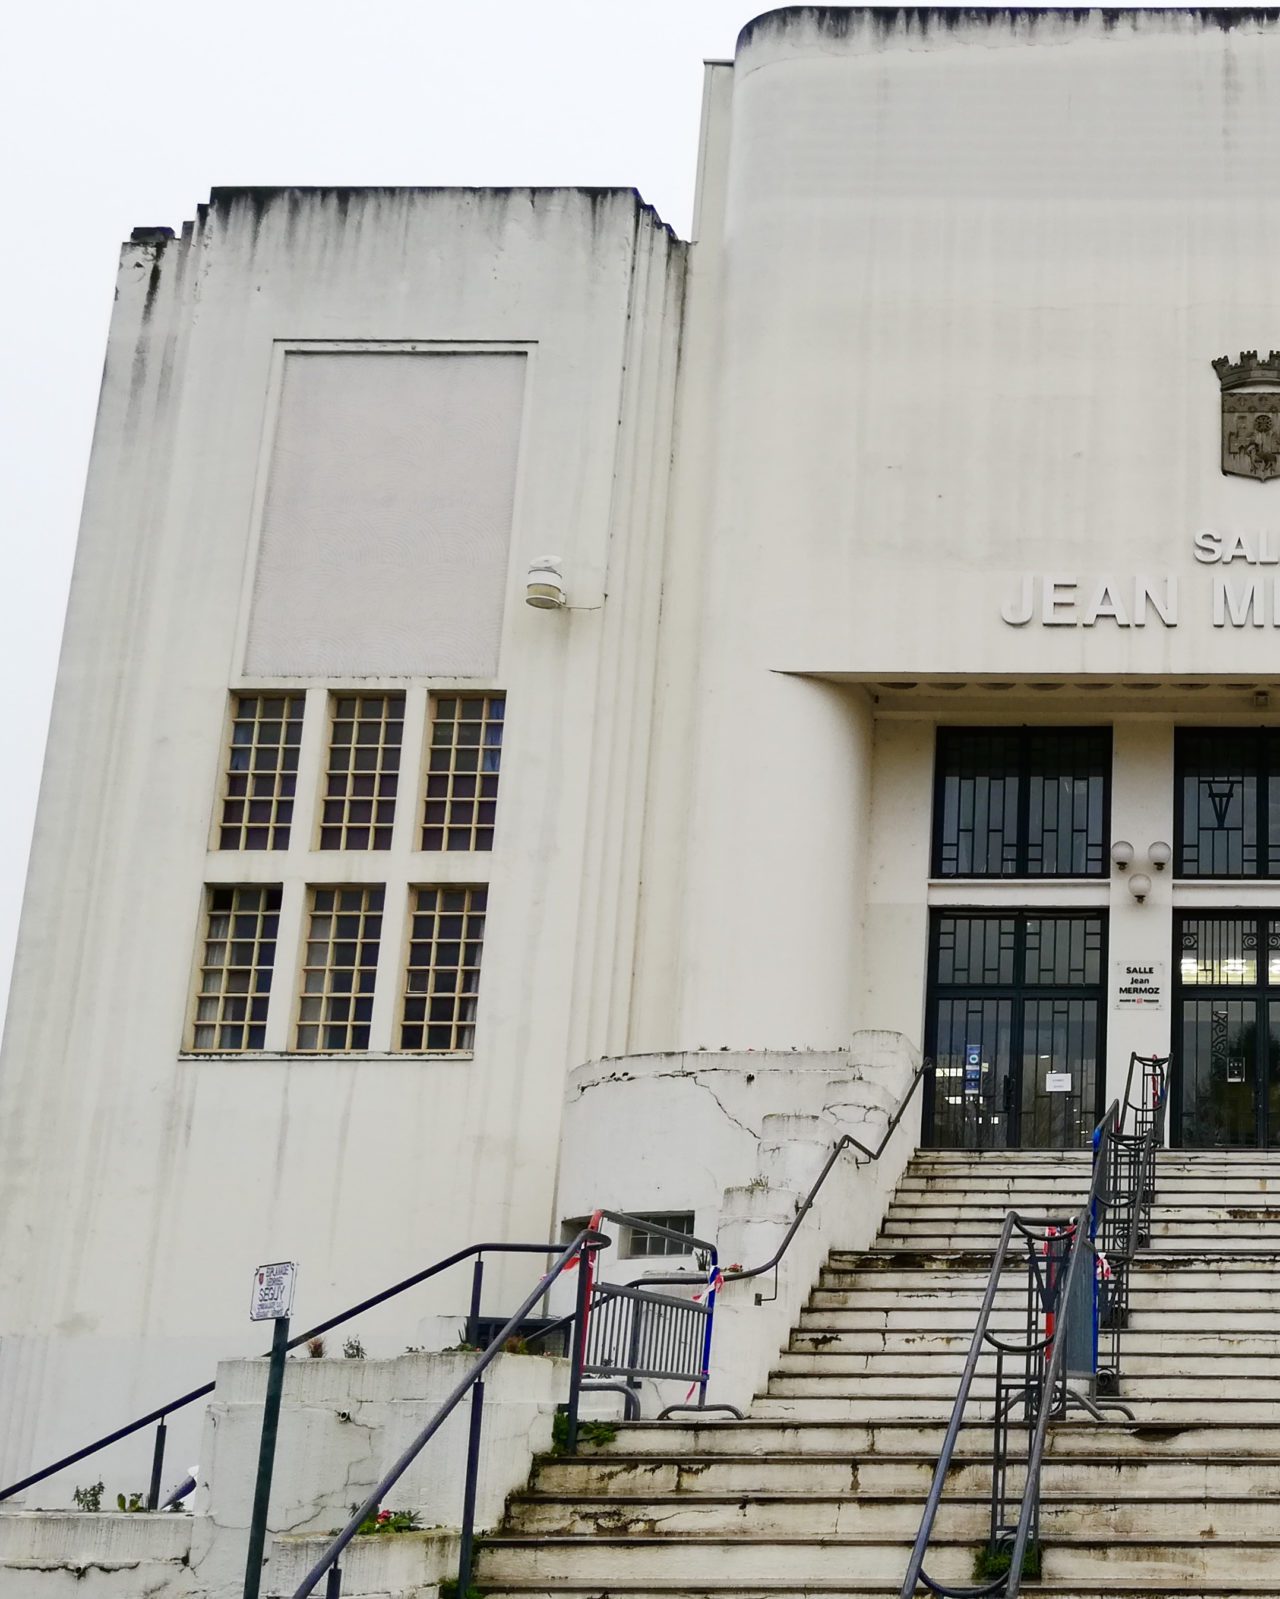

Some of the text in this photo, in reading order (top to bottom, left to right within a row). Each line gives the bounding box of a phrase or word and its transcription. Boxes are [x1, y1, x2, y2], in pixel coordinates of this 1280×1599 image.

[1000, 574, 1178, 628] JEAN
[1126, 966, 1154, 974] SALLE
[1130, 977, 1150, 985] Jean
